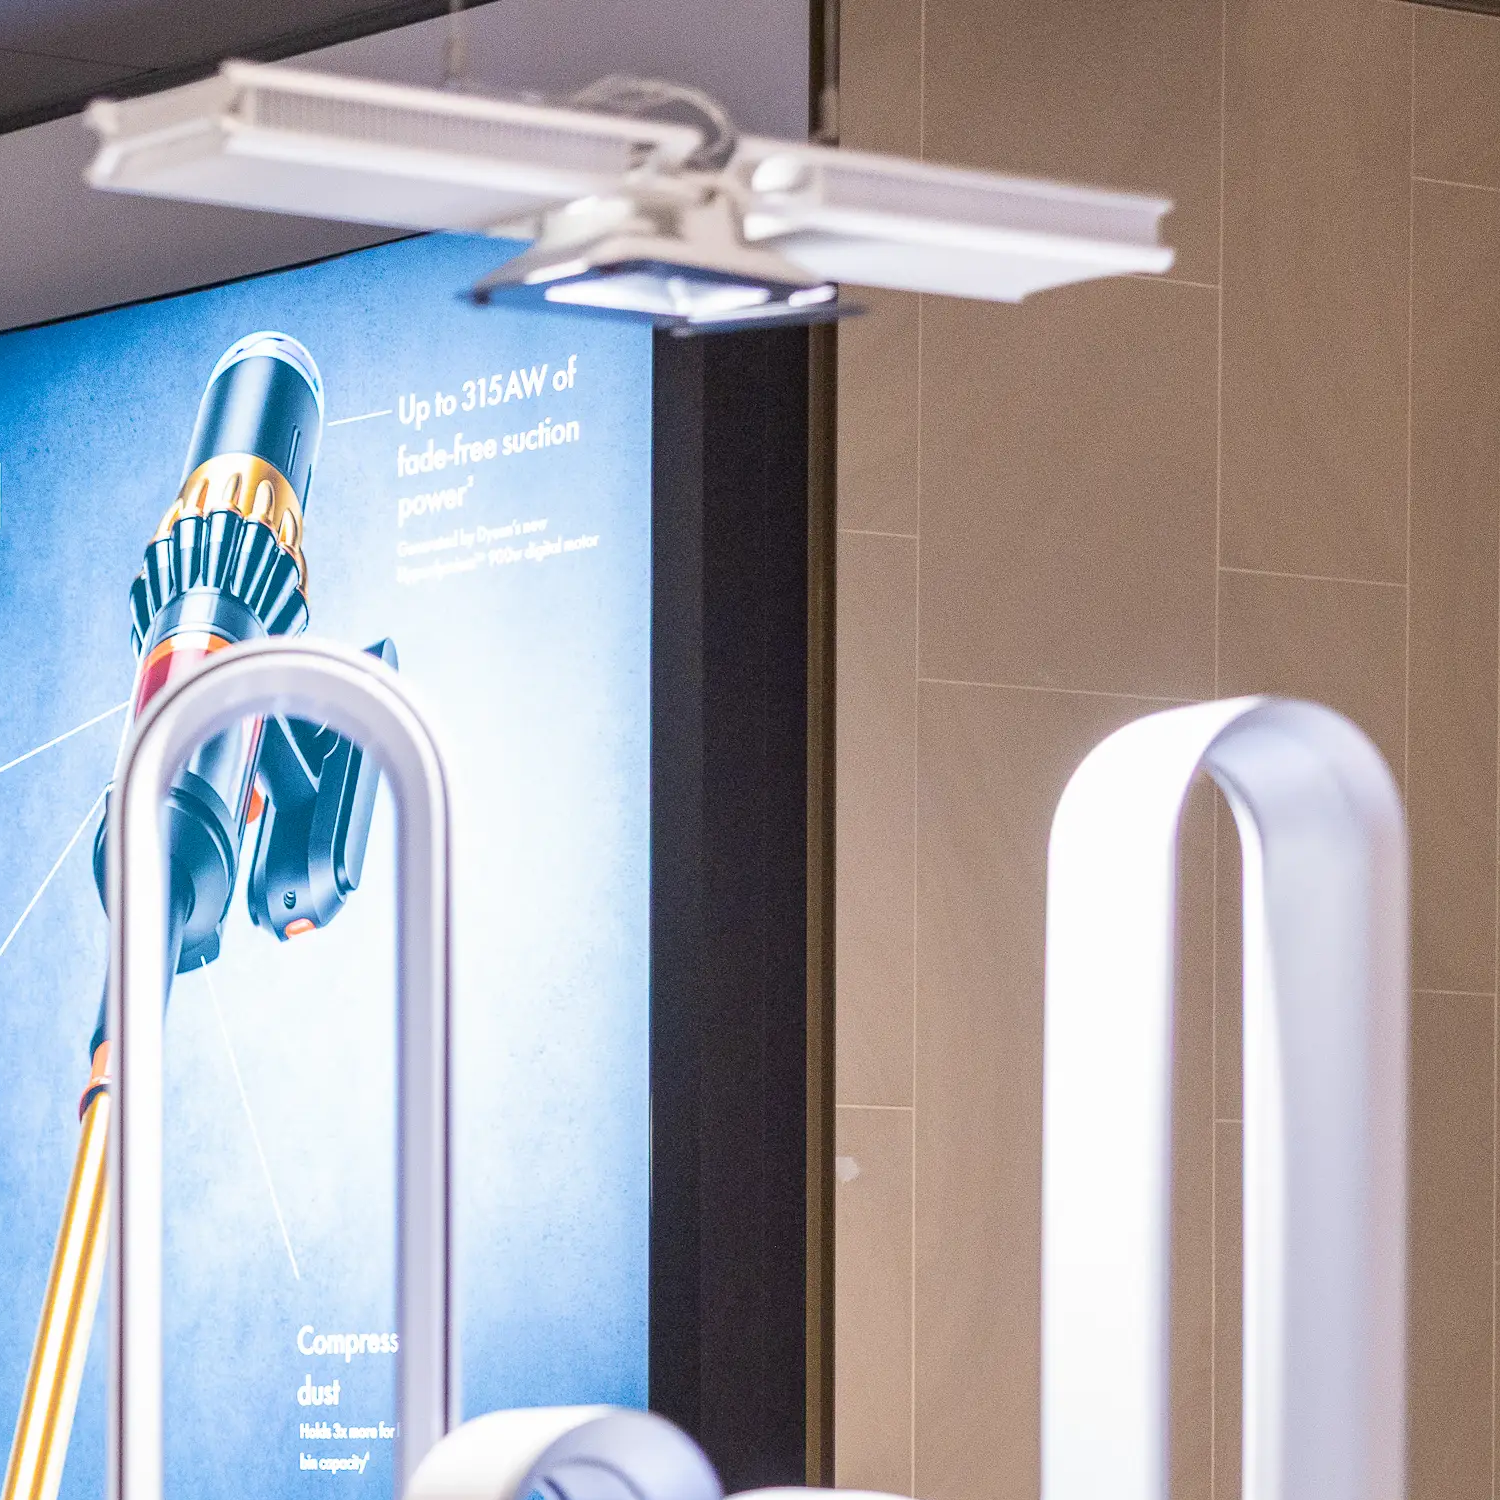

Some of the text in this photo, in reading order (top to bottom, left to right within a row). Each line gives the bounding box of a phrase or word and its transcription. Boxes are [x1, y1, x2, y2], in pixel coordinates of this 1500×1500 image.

[398, 354, 577, 431] Up to 315AW of
[397, 416, 580, 478] fade-free suction
[563, 534, 600, 553] motor
[297, 1324, 399, 1363] Compress
[297, 1374, 341, 1406] dust
[300, 1421, 331, 1439] Holds
[299, 1451, 318, 1471] bin
